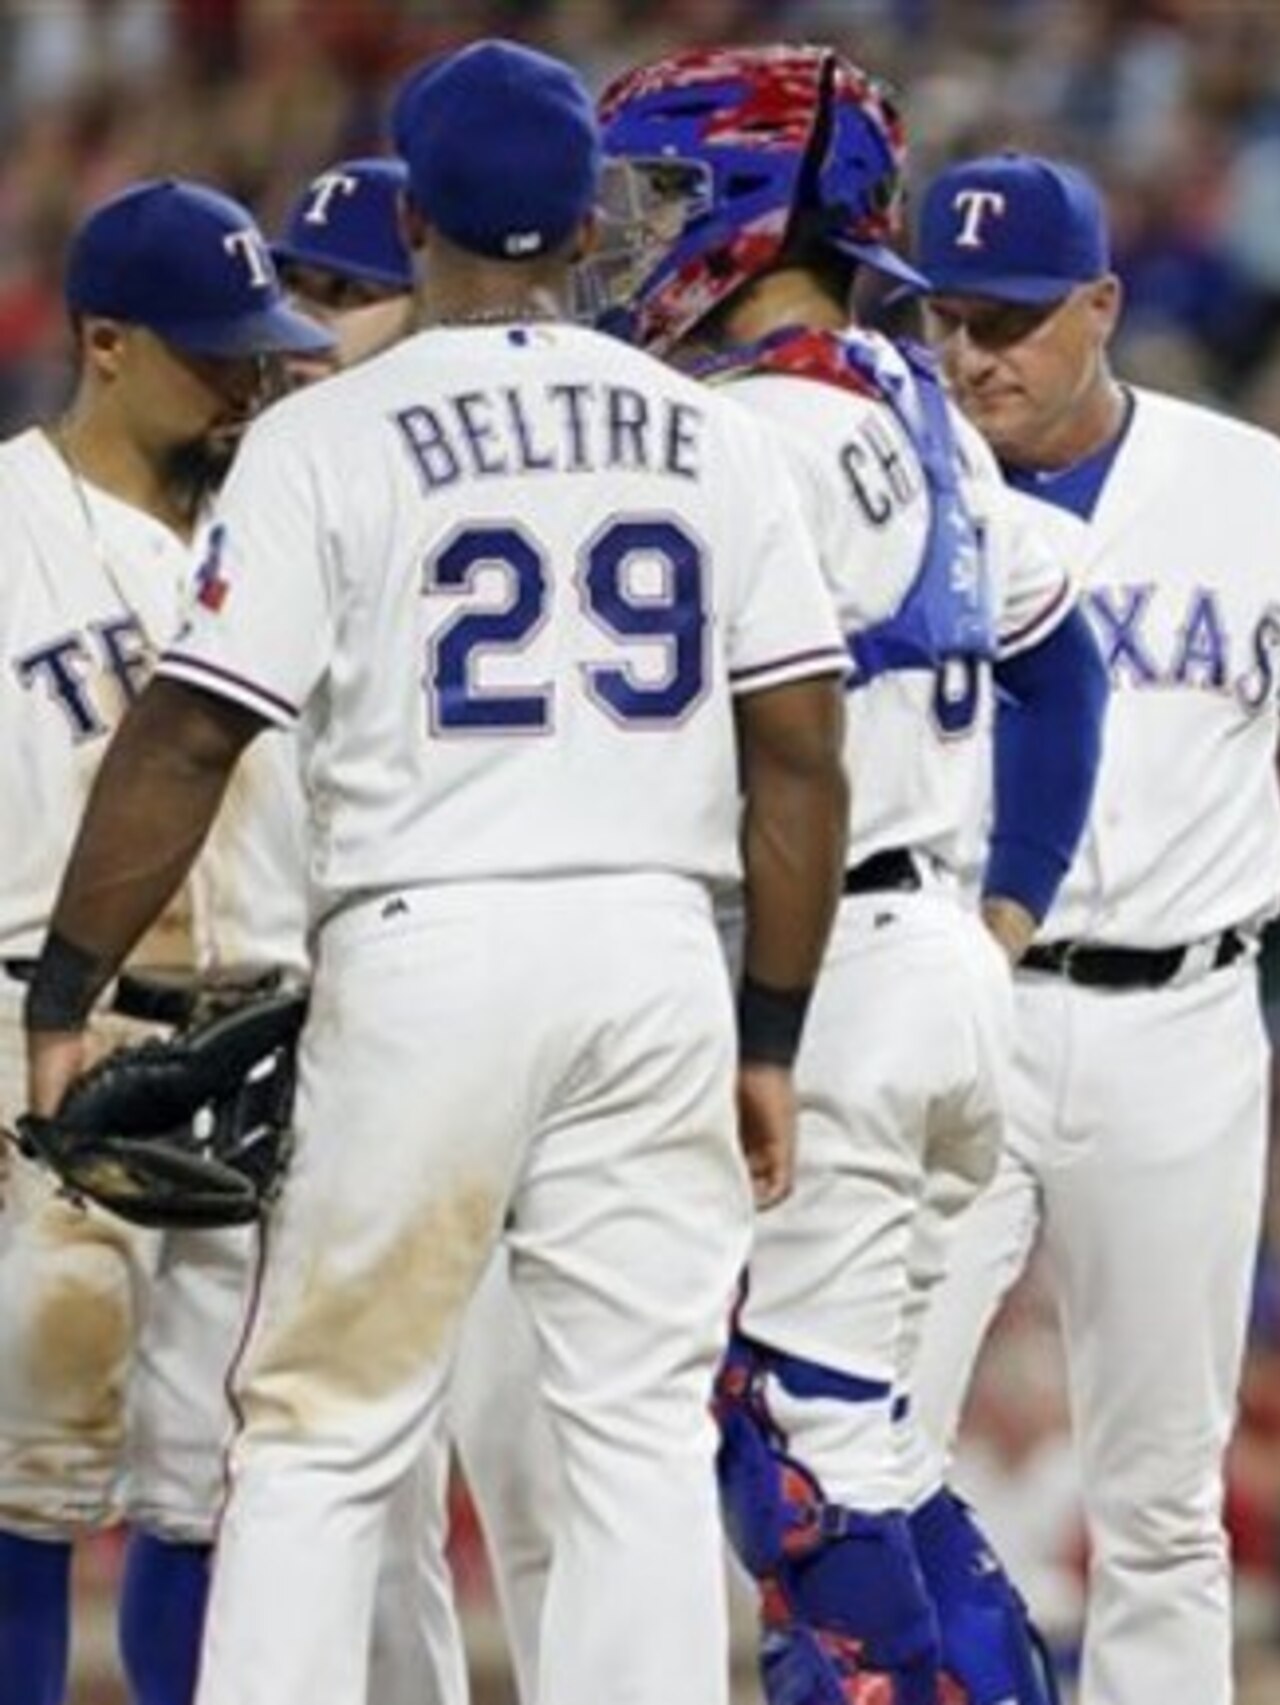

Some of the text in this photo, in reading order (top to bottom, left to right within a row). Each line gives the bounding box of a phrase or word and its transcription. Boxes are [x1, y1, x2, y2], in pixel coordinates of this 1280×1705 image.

[304, 171, 358, 225] T
[954, 188, 1005, 247] T
[223, 227, 270, 287] T
[390, 383, 704, 495] BELTRE
[420, 507, 716, 738] 29
